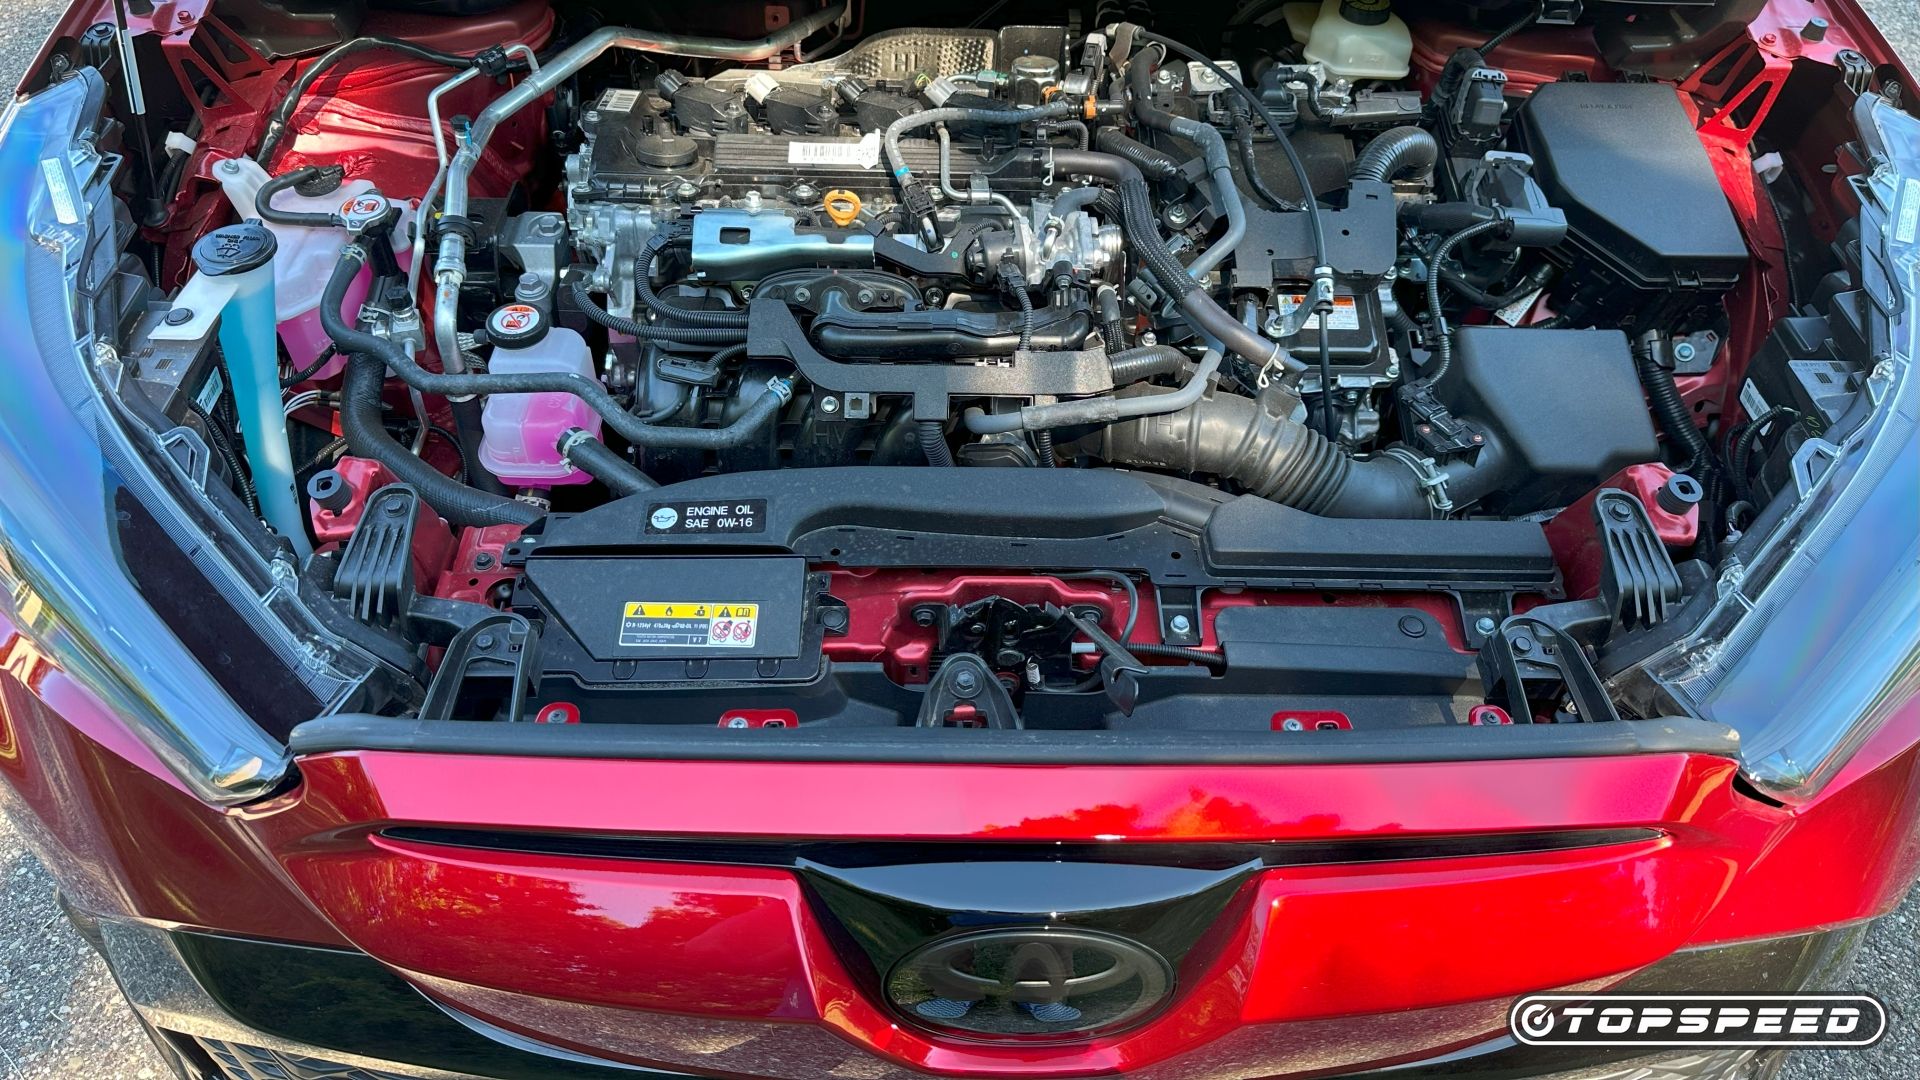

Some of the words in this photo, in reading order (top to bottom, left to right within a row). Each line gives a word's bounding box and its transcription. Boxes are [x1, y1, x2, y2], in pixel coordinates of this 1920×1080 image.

[686, 505, 728, 516] ENGINE
[735, 505, 755, 515] OIL
[685, 518, 709, 528] SAE
[717, 517, 753, 528] 0W-16
